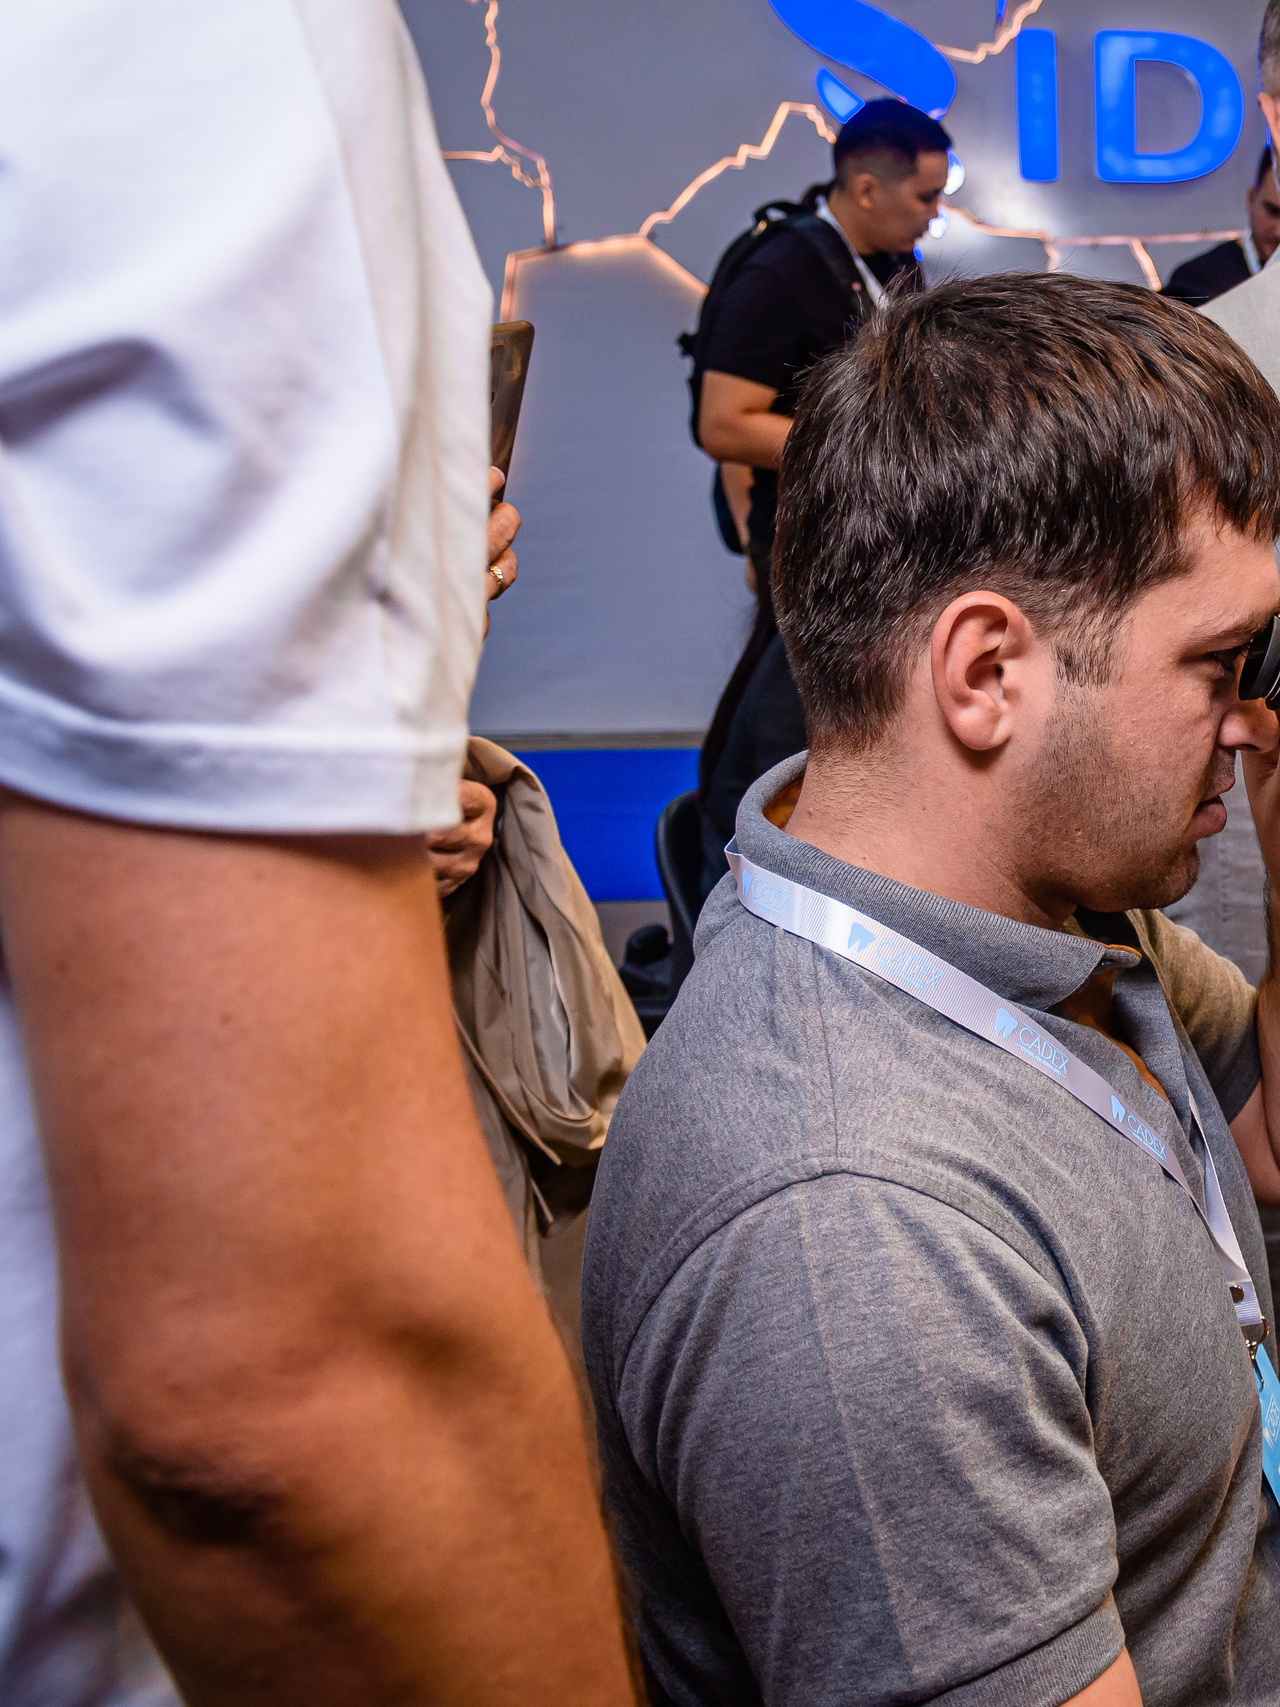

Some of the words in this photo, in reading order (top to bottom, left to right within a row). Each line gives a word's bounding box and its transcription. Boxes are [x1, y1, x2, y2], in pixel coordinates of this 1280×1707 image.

[1015, 28, 1262, 182] ID
[875, 938, 944, 991] CADEX
[1019, 1024, 1069, 1071] CADEX
[1126, 1112, 1168, 1158] CADEX
